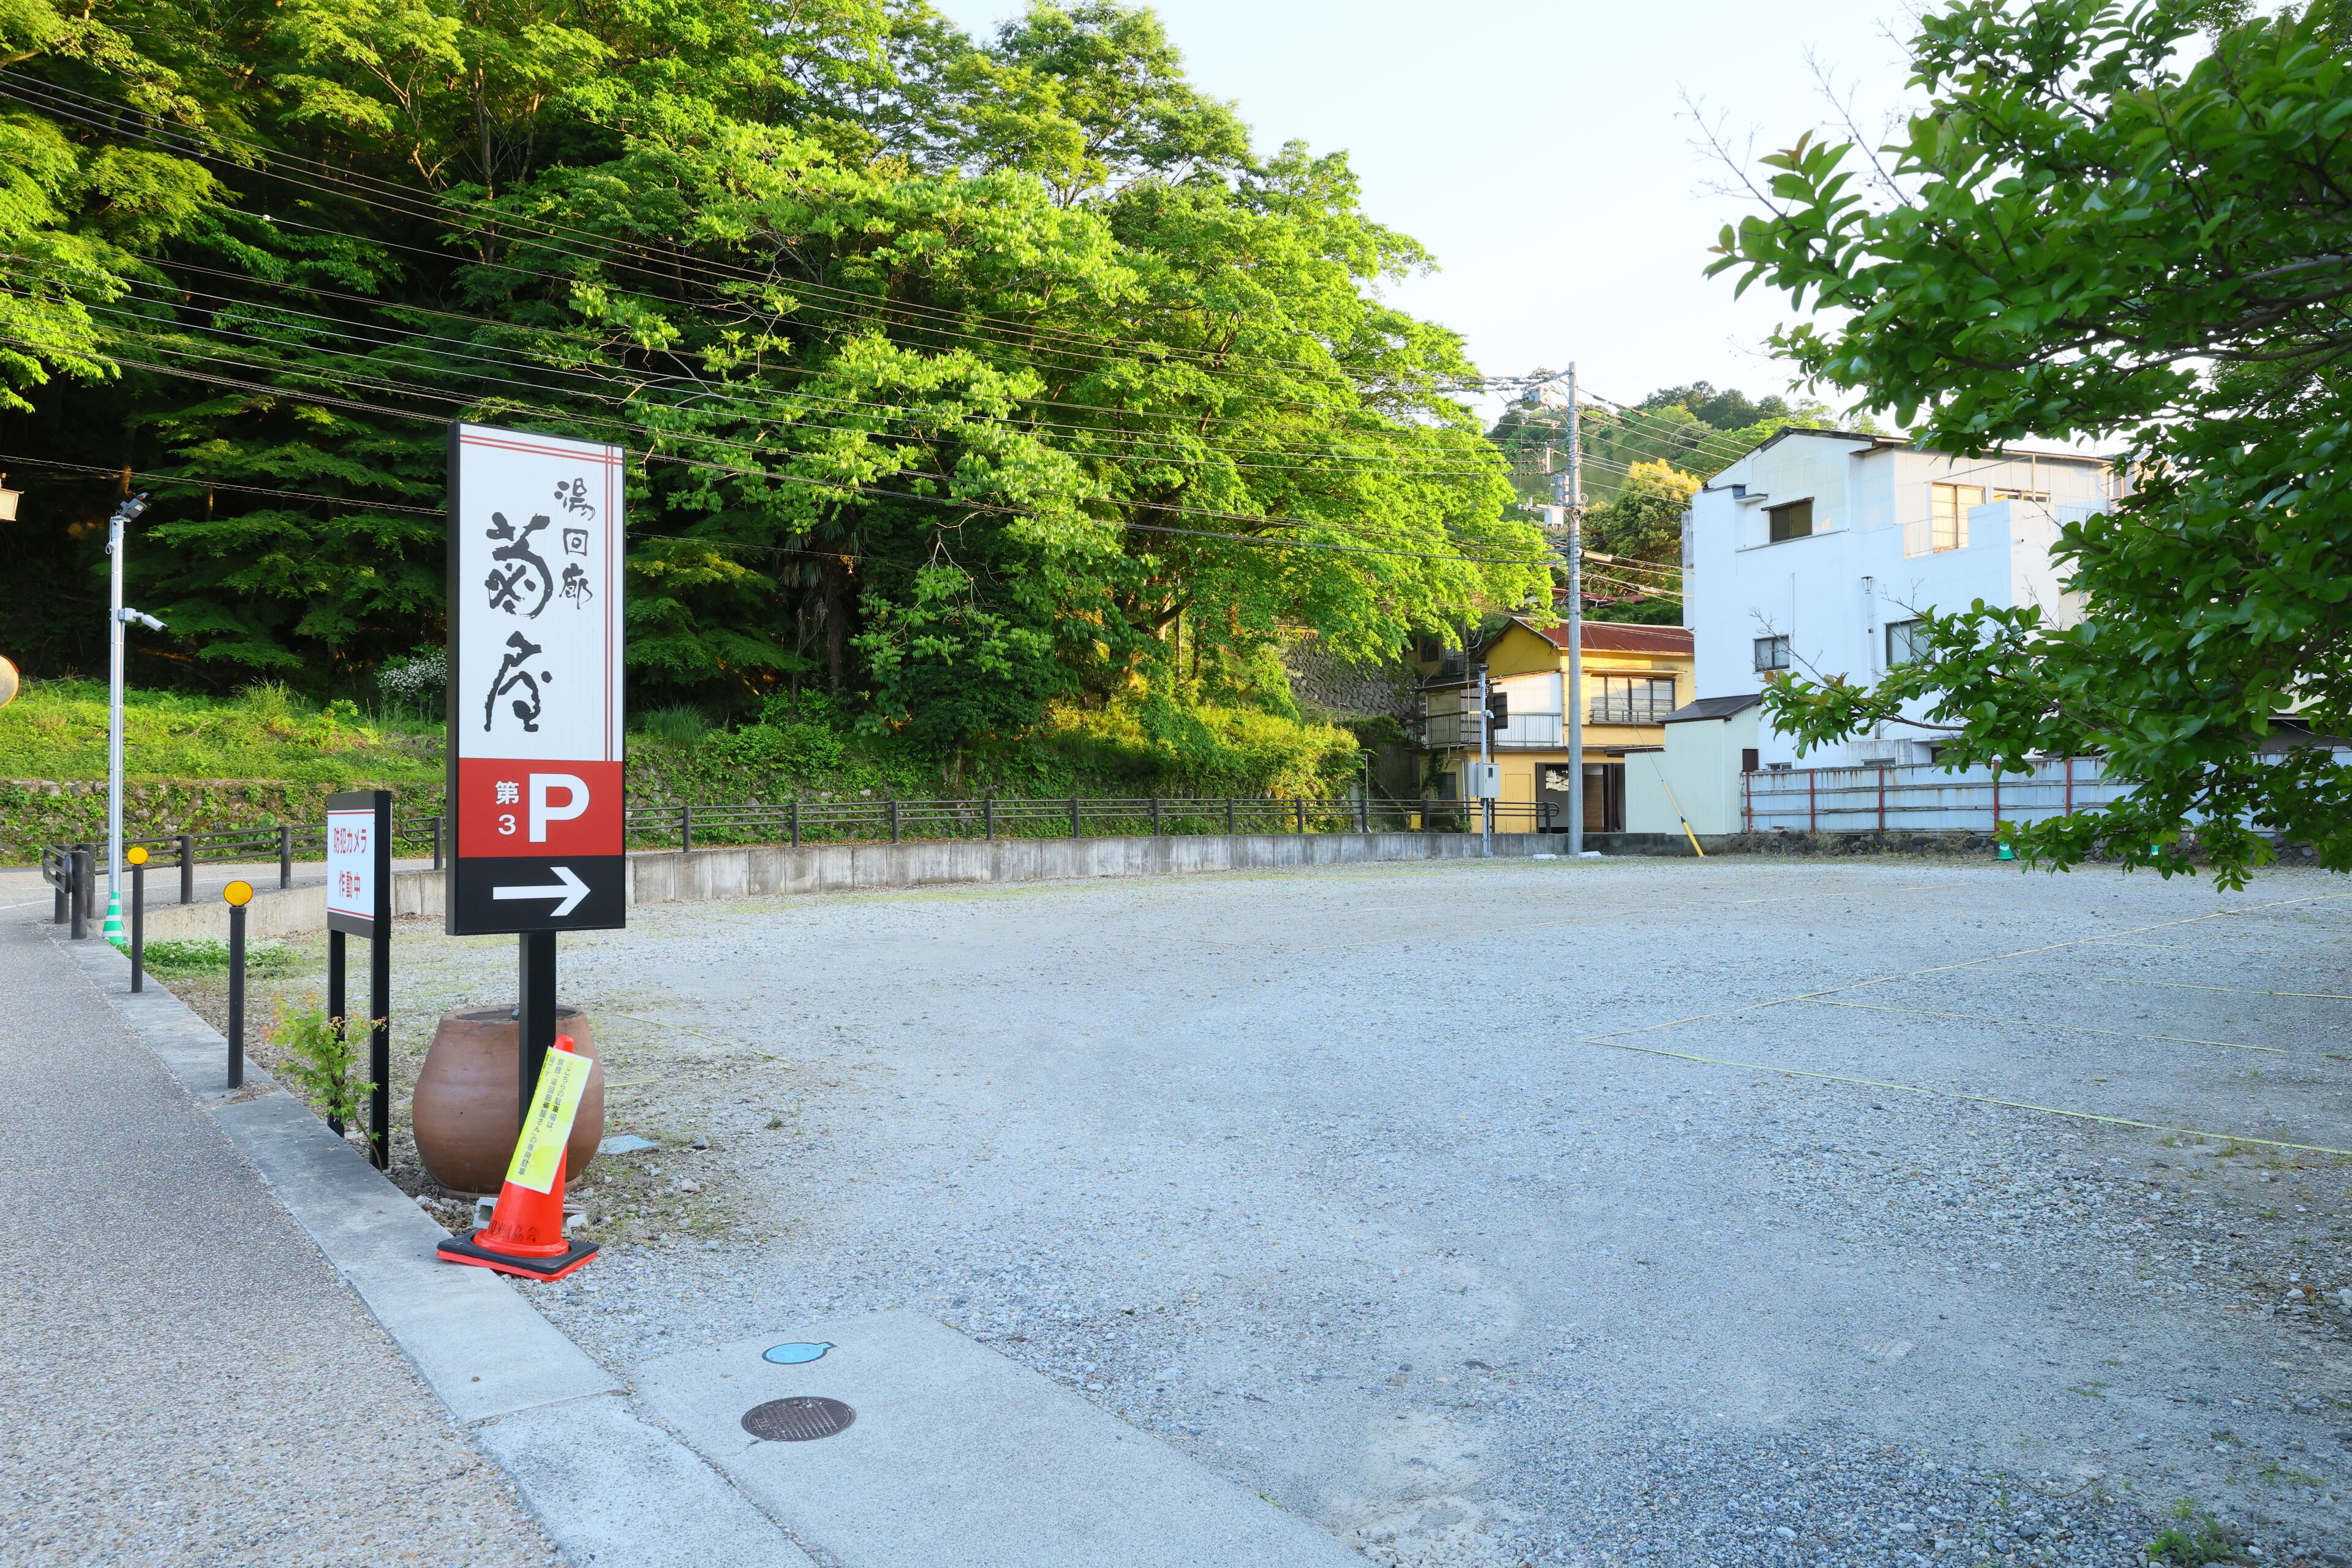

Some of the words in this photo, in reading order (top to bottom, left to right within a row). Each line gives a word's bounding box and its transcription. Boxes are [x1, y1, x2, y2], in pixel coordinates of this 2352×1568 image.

[554, 477, 596, 610] 湯回廊
[483, 511, 554, 733] 菊屋
[333, 827, 367, 854] 防犯カメラ
[529, 773, 590, 843] P
[339, 870, 361, 900] 作動中
